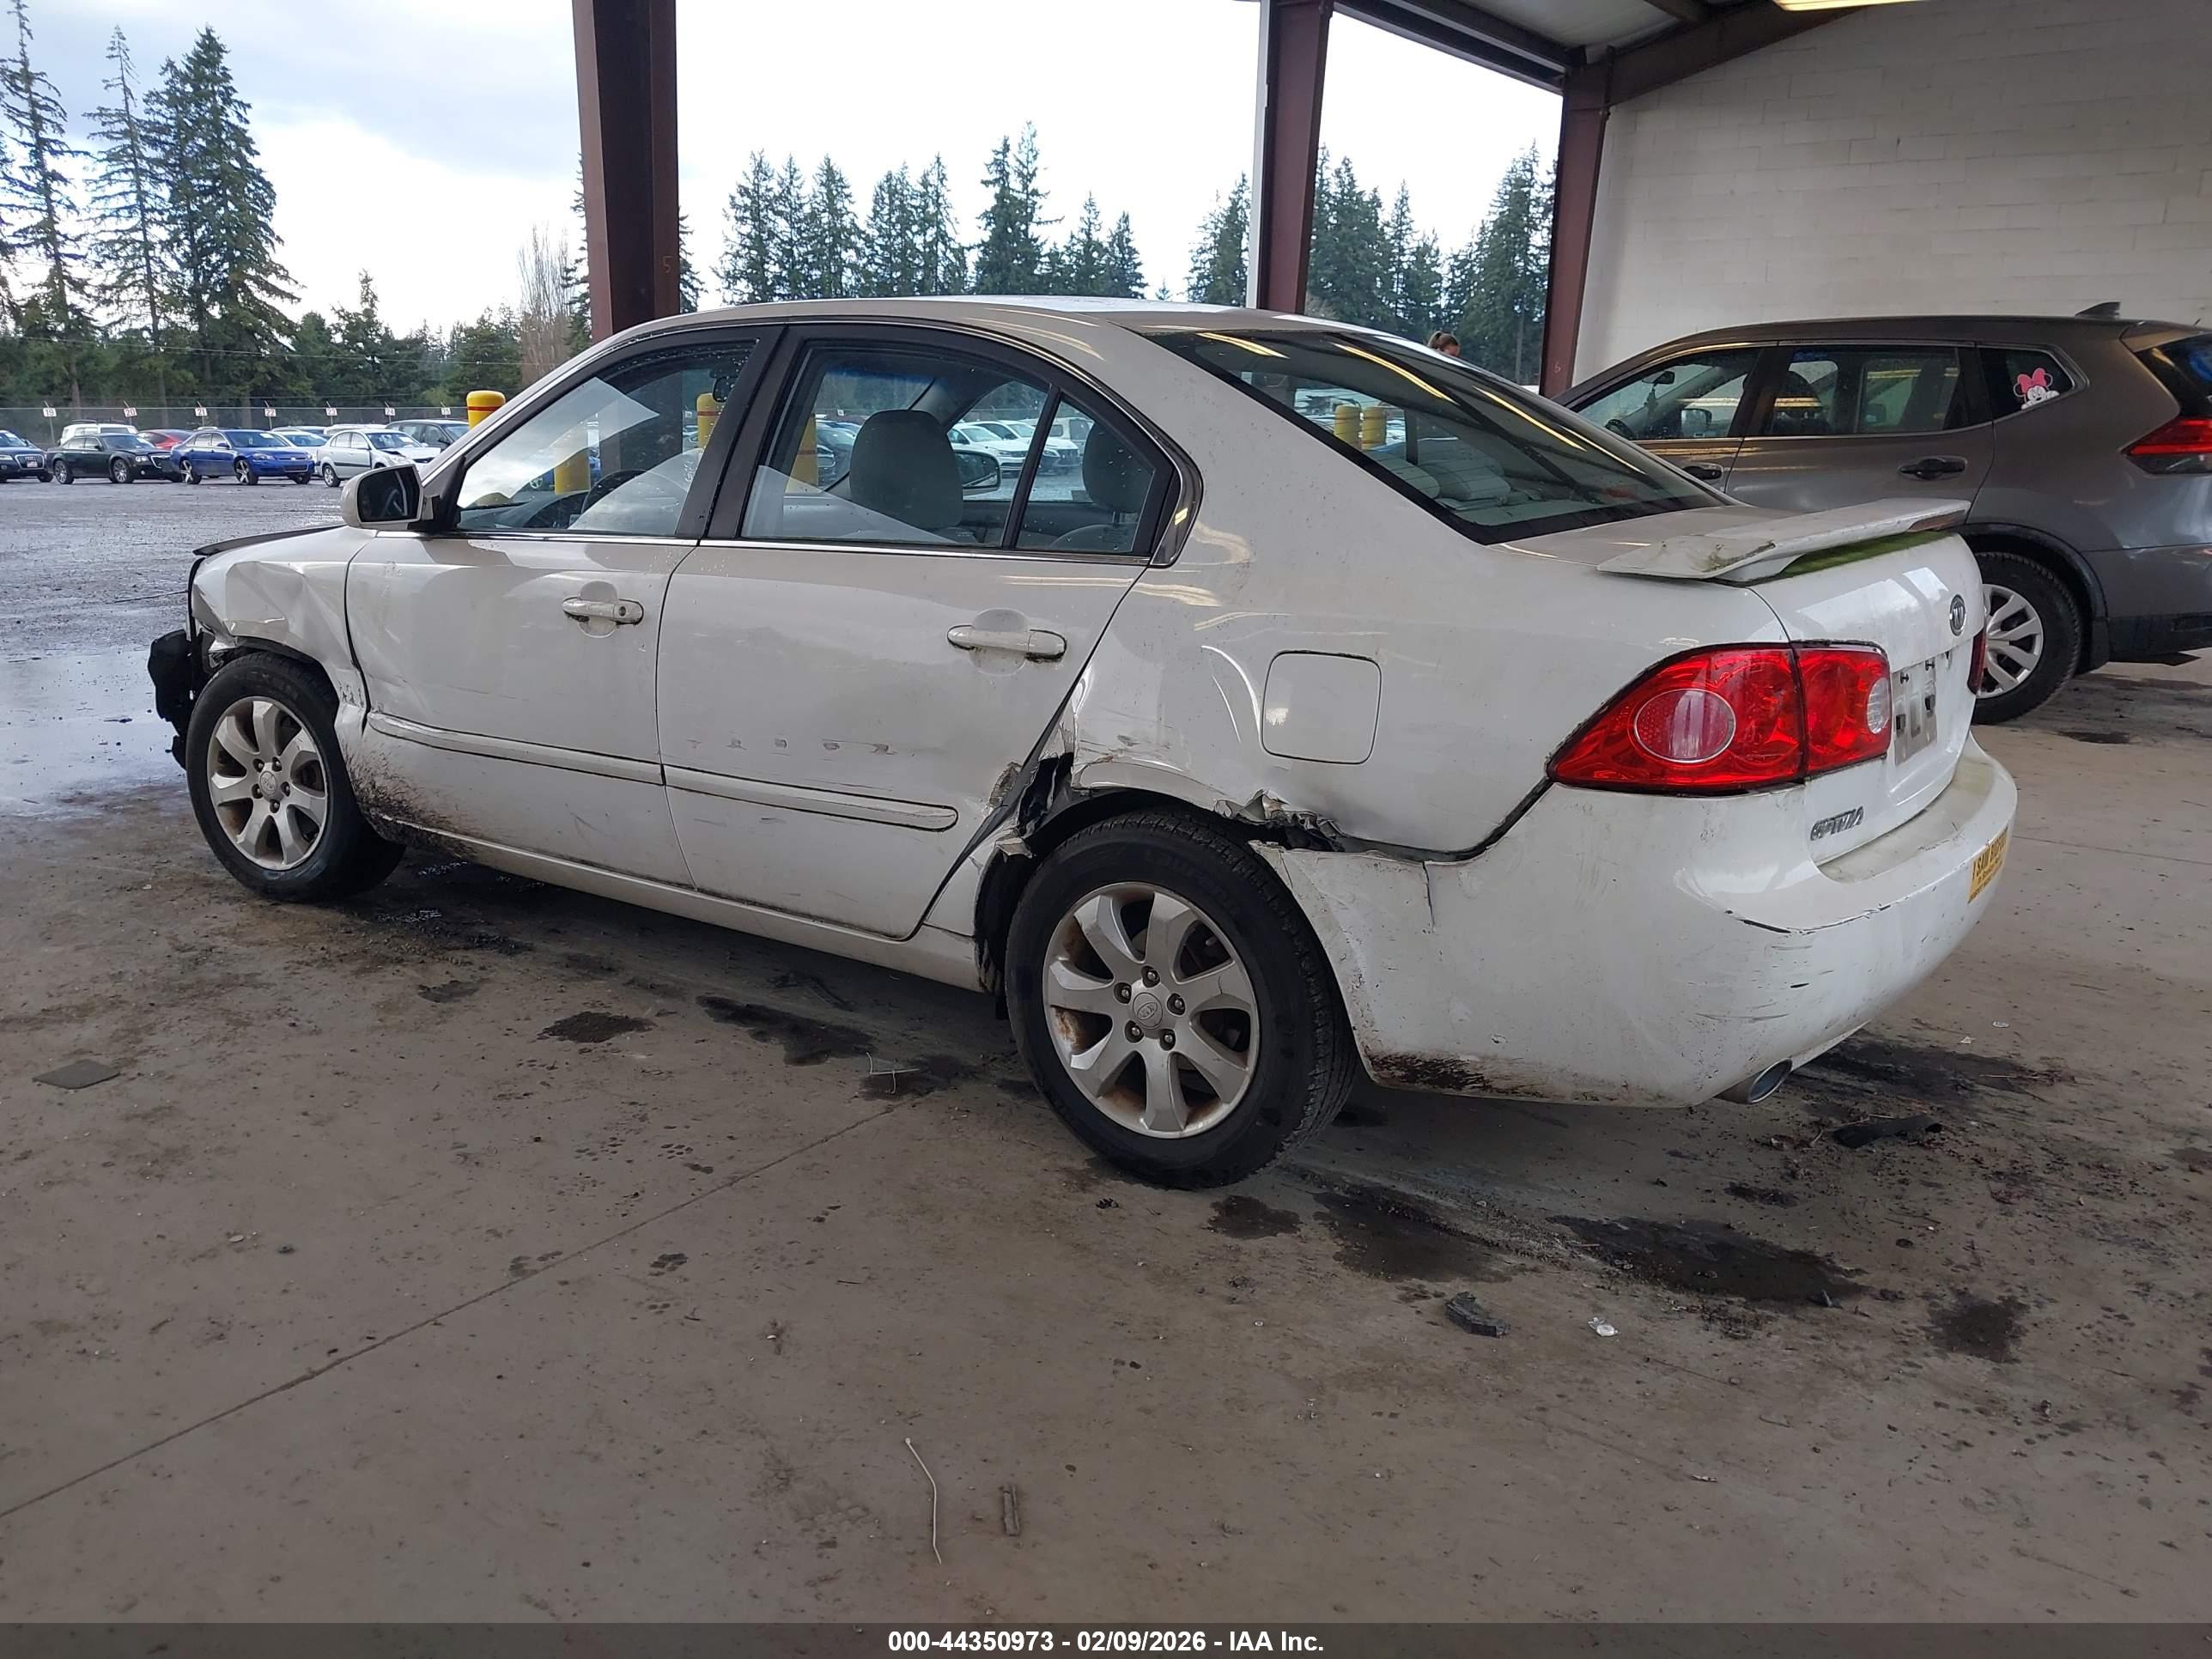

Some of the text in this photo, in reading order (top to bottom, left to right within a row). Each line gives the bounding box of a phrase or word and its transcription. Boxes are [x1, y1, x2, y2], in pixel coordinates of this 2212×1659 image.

[46, 408, 55, 416] 19
[125, 408, 136, 416] 20
[197, 408, 206, 416] 21
[265, 408, 275, 416] 22
